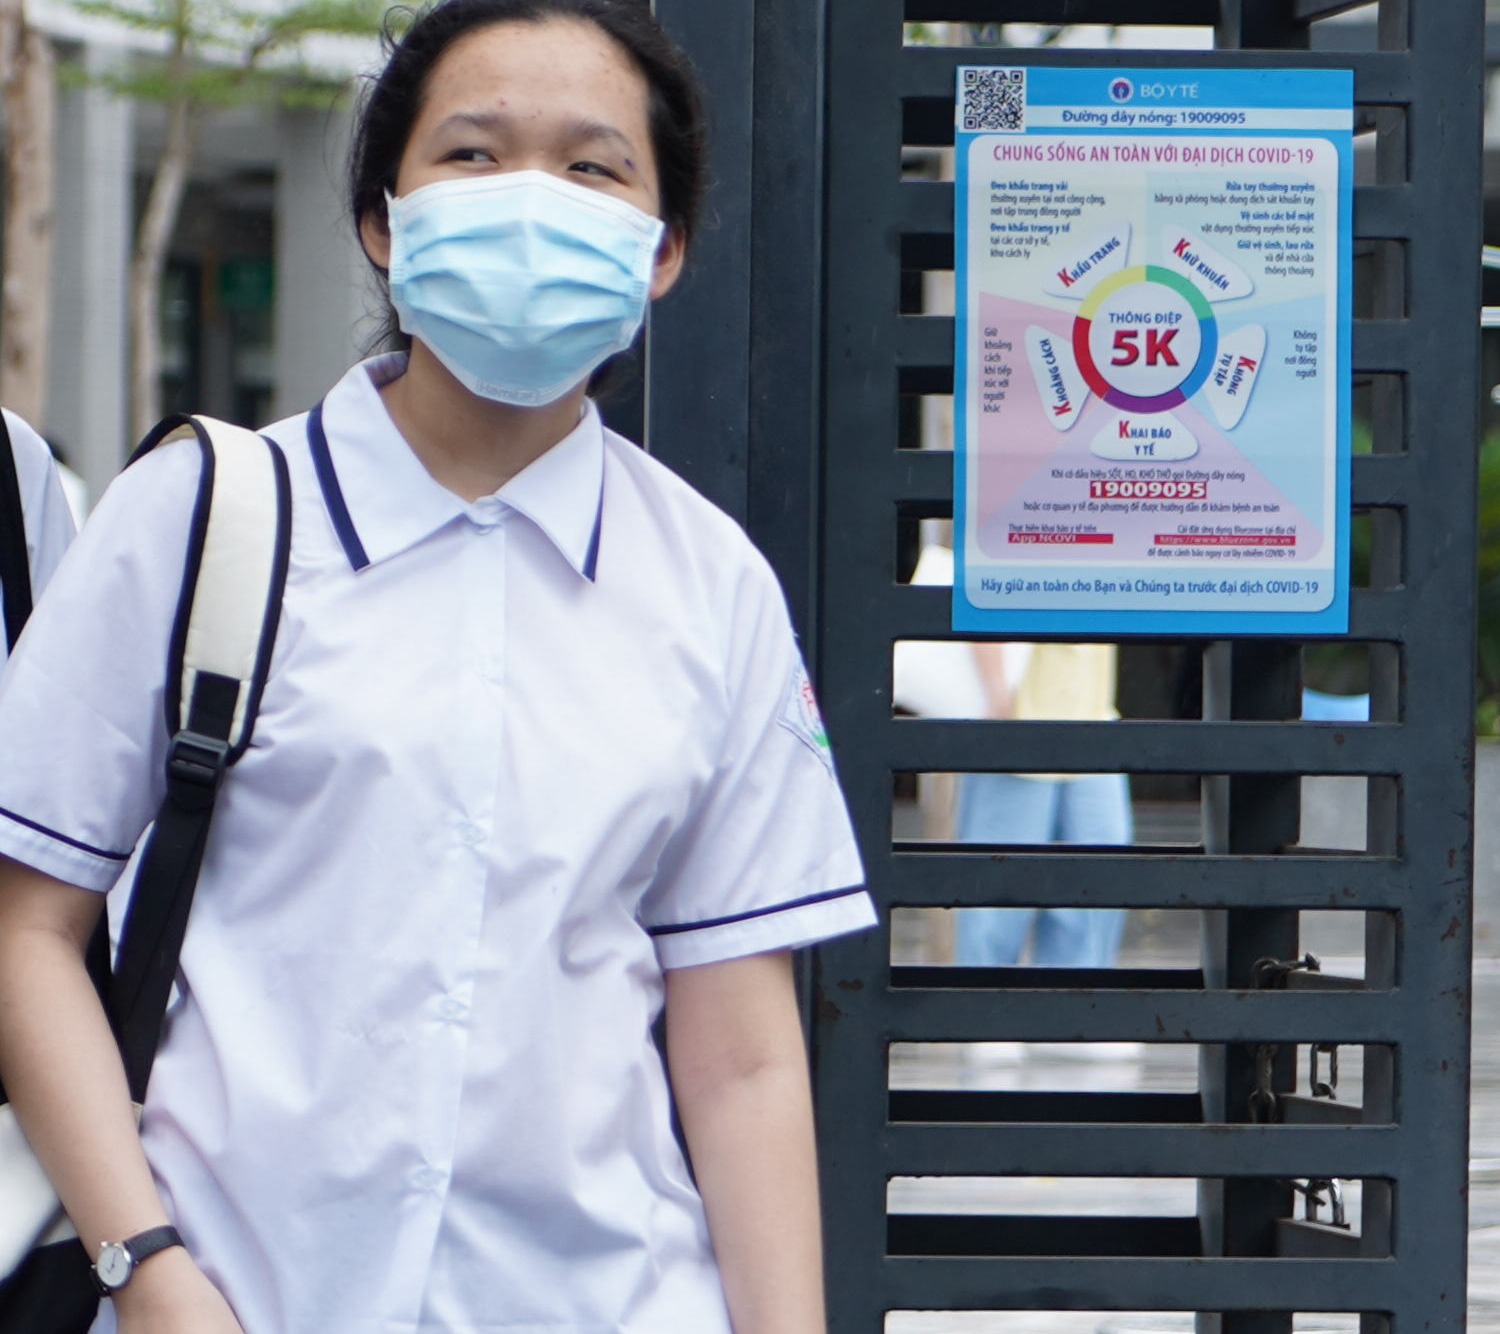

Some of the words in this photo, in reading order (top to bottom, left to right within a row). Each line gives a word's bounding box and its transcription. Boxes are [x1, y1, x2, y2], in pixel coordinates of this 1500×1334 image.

[1141, 83, 1164, 99] BỘ
[1166, 85, 1177, 97] Y
[1181, 83, 1199, 98] TẾ
[1062, 110, 1108, 125] Đường
[1111, 110, 1135, 125] dây
[1139, 111, 1177, 126] nóng:
[1181, 113, 1245, 124] 19009095
[993, 145, 1043, 161] CHUNG
[1047, 142, 1085, 161] SỐNG
[1090, 146, 1109, 161] AN
[1114, 144, 1150, 162] TOÀN
[1154, 145, 1177, 162] VỚI
[1182, 147, 1206, 167] ĐẠI
[1211, 147, 1243, 167] DỊCH
[1249, 148, 1313, 163] COVID-19
[1089, 236, 1121, 265] TRANG
[1109, 312, 1151, 324] THÔNG
[1155, 312, 1182, 327] ĐIỆP
[1039, 339, 1056, 365] CÁCH
[1110, 329, 1180, 366] 5K
[1227, 356, 1257, 395] KHÔNG
[1119, 421, 1147, 439] KHAI
[1151, 428, 1171, 439] BÁO
[1135, 446, 1141, 455] Y
[1143, 443, 1155, 455] TẾ
[1092, 482, 1206, 497] 19009095
[1012, 534, 1036, 543] App
[1039, 534, 1076, 542] NCOVI
[982, 579, 1002, 593] Hãy
[1005, 579, 1023, 594] giữ
[1026, 582, 1040, 591] an
[1044, 580, 1068, 591] toàn
[1072, 580, 1091, 592] cho
[1095, 580, 1115, 594] Bạn
[1119, 581, 1131, 592] và
[1135, 580, 1171, 595] Chúng
[1174, 583, 1184, 593] ta
[1188, 581, 1217, 593] trước
[1220, 581, 1238, 596] đại
[1240, 581, 1263, 596] dịch
[1266, 582, 1318, 593] COVID-19
